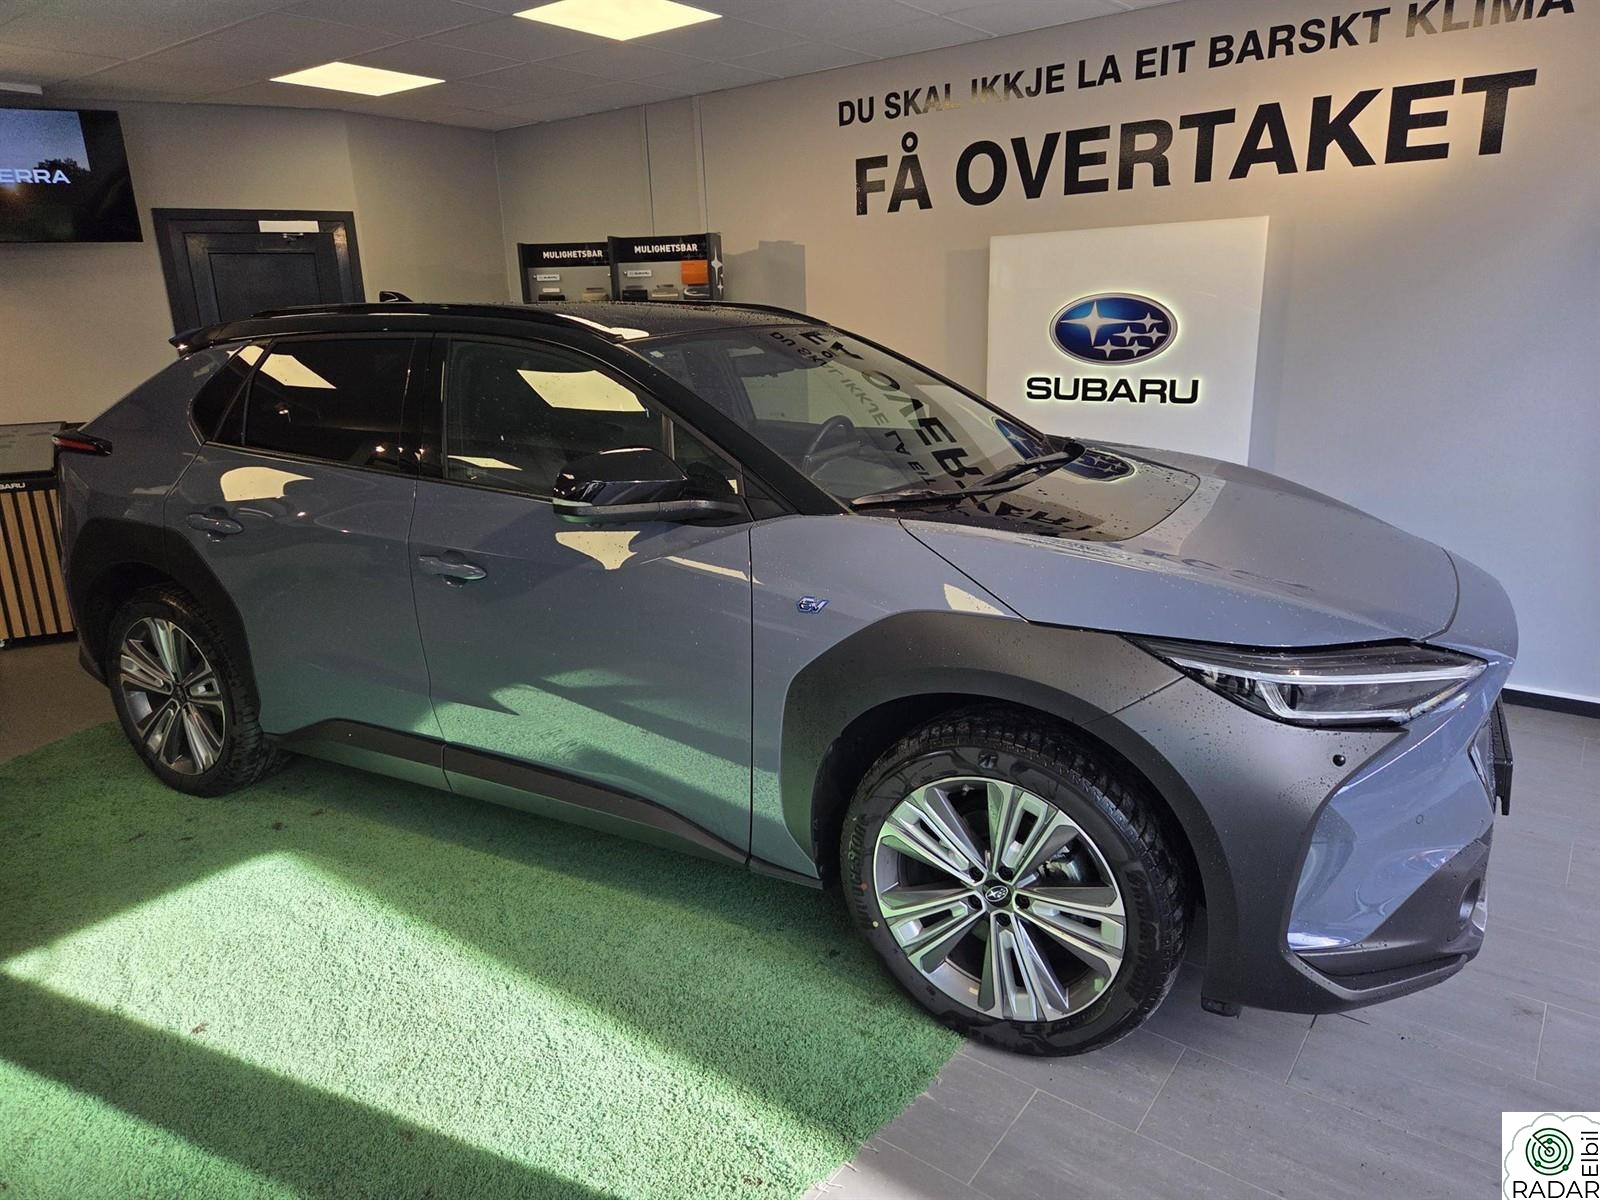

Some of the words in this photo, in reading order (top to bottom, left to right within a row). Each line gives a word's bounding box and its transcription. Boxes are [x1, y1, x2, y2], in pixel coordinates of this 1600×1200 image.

[838, 96, 875, 127] DU
[884, 82, 961, 120] SKAL
[970, 63, 1065, 105] IKKJE
[1077, 54, 1122, 89] LA
[1135, 40, 1196, 80] EIT
[1208, 8, 1391, 69] BARSKT
[855, 131, 933, 216] FÅ
[956, 68, 1538, 206] OVERTAKET
[0, 168, 72, 184] ERRA
[543, 249, 603, 260] MULIGHETSBAR
[634, 243, 698, 255] MULIGHETSBAR
[1026, 376, 1199, 404] SUBARU
